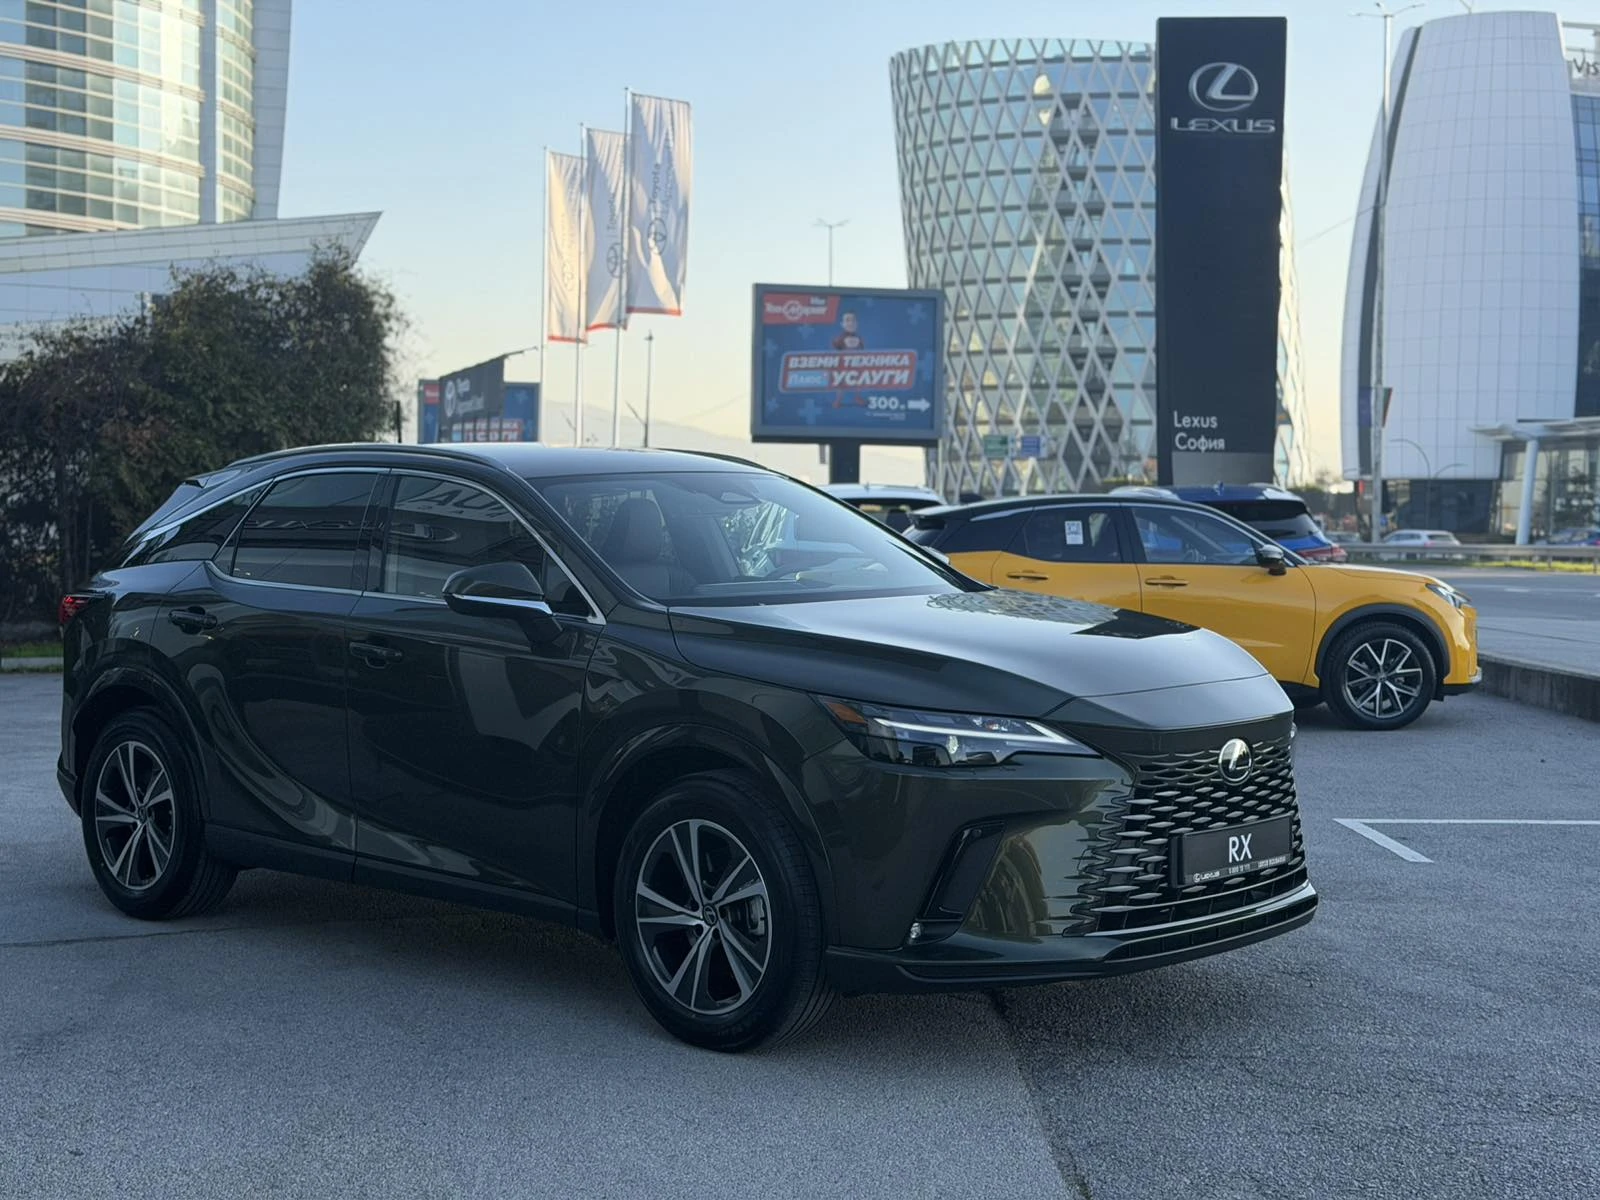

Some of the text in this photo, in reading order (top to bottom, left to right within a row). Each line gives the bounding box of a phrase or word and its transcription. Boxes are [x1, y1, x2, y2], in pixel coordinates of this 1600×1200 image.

[1170, 116, 1276, 134] LEXUS
[789, 355, 910, 368] ВЗЕМИ ТЕХНИКА
[832, 370, 910, 386] УСЛУГИ
[1173, 410, 1218, 428] Lexus
[1175, 432, 1226, 454] София
[1228, 833, 1252, 863] RX
